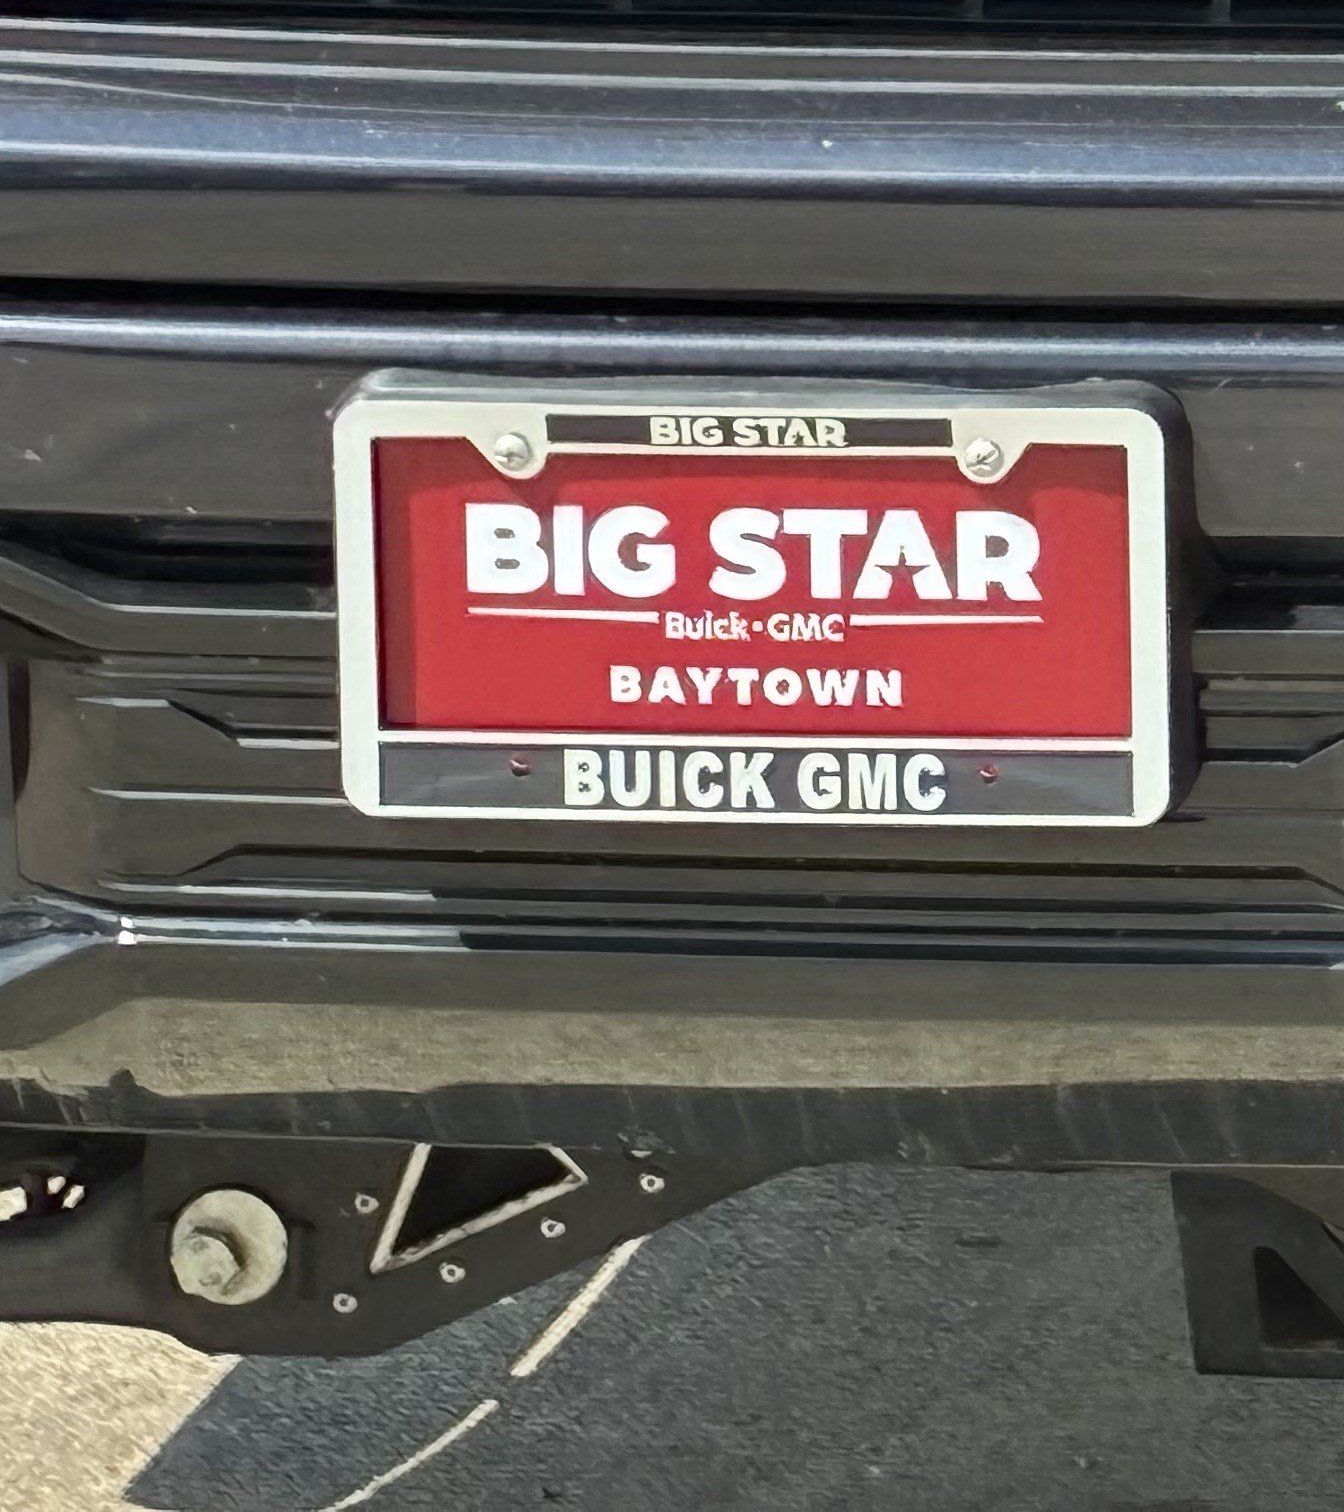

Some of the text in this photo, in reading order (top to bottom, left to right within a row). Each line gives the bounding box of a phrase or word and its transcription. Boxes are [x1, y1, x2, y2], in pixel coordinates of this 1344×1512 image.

[650, 416, 849, 447] BIG STAR
[466, 502, 1042, 602] BIG STAR
[609, 664, 904, 708] BAYTOWN
[563, 748, 948, 812] BUICK GMC
